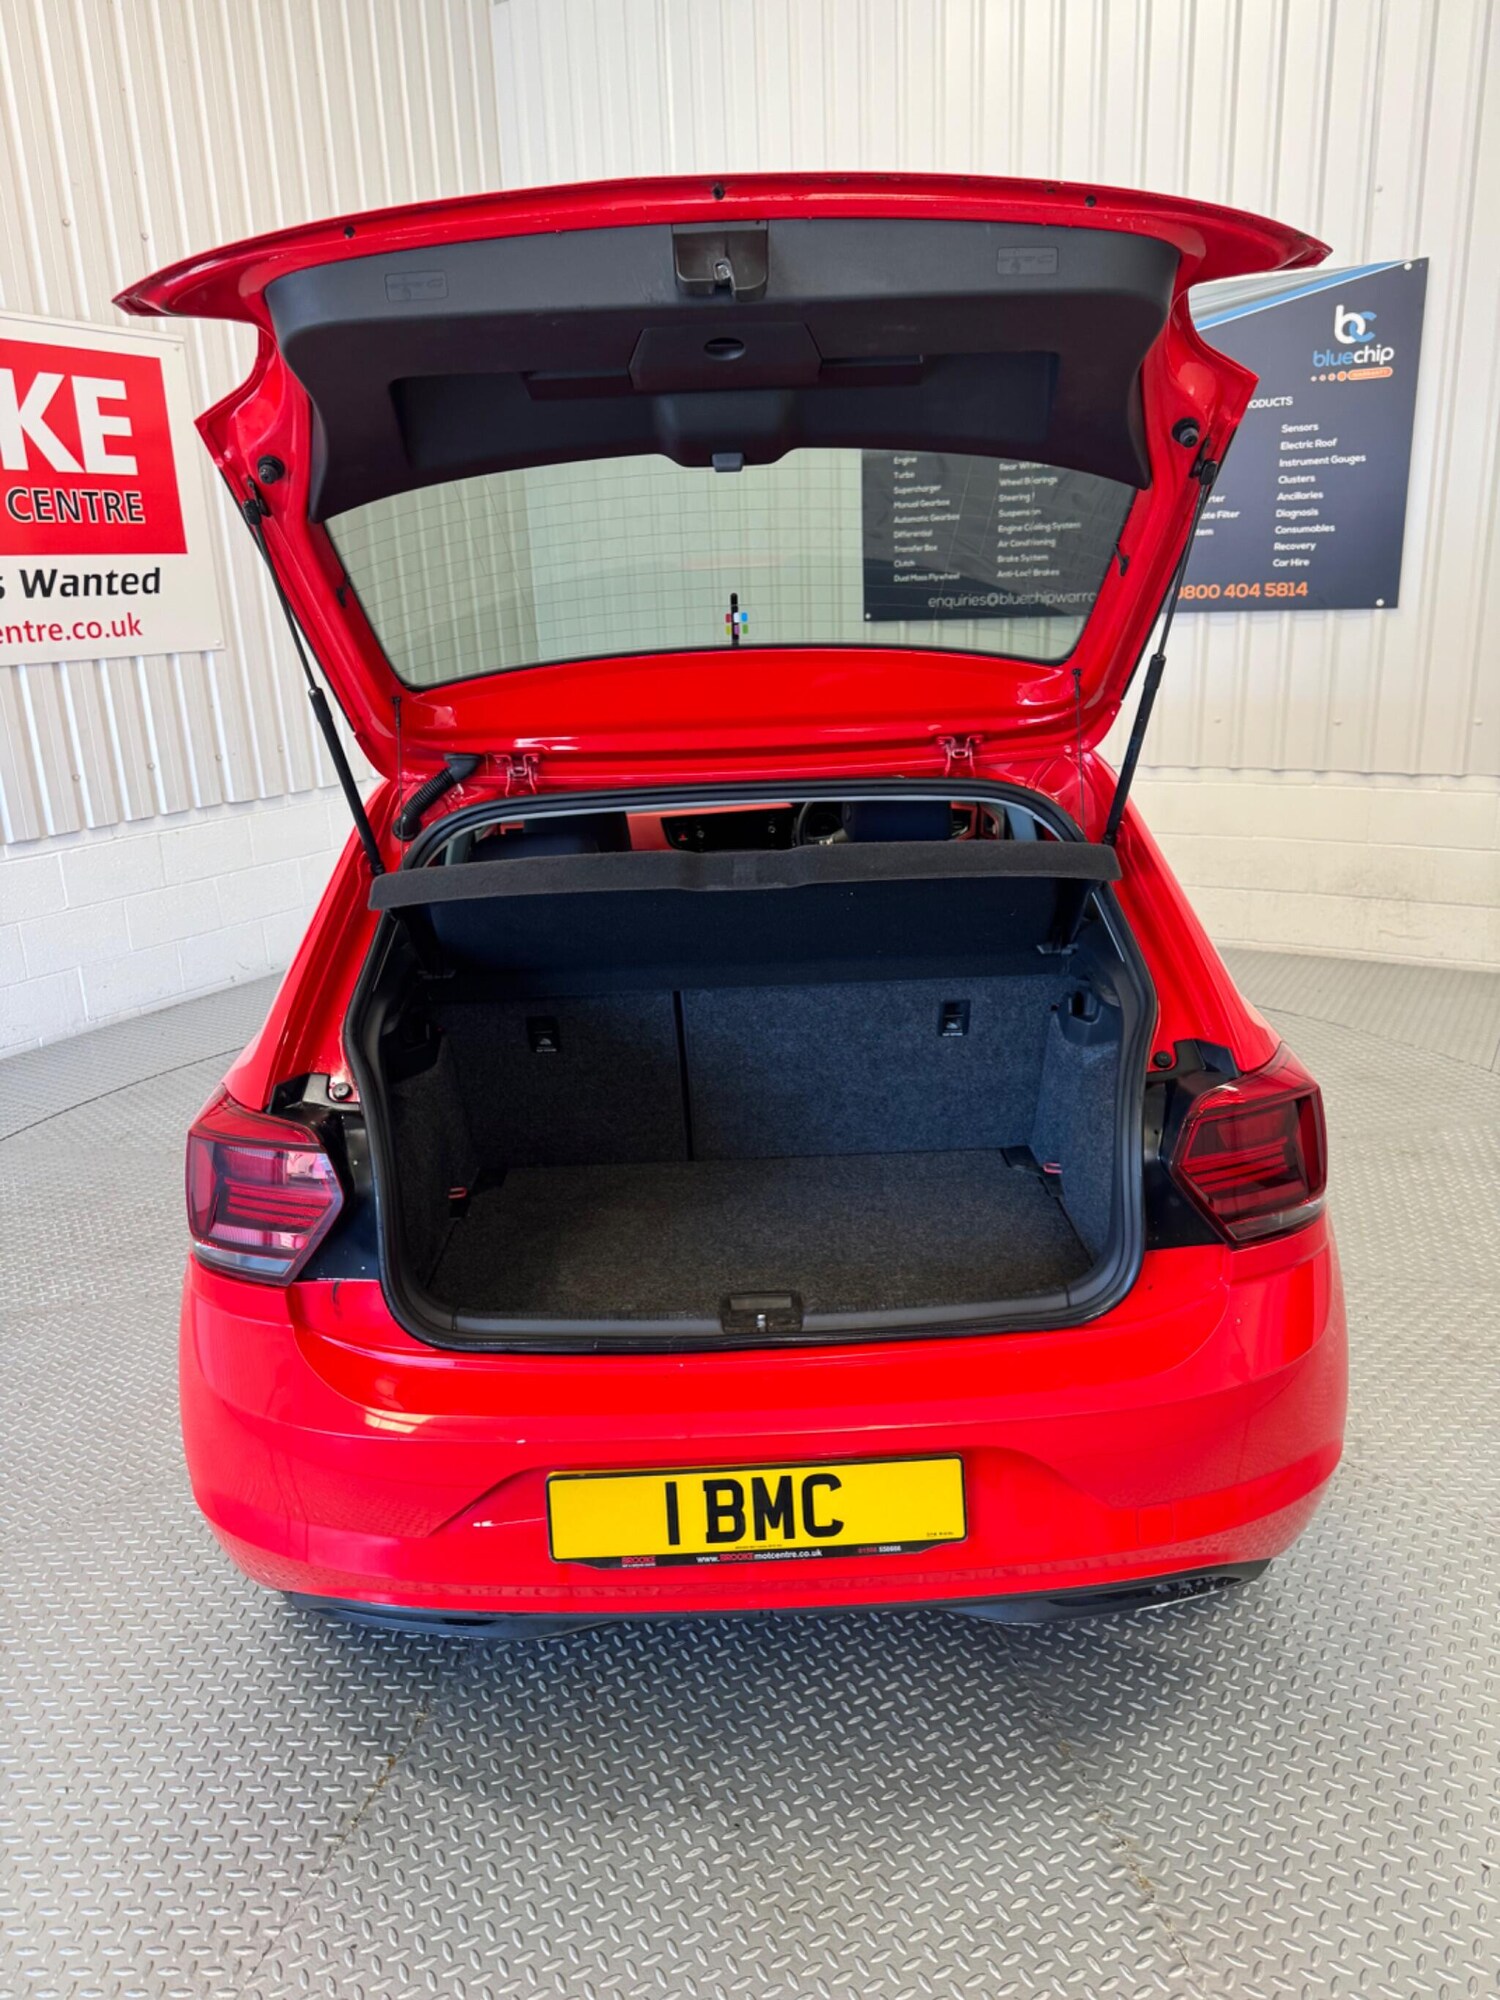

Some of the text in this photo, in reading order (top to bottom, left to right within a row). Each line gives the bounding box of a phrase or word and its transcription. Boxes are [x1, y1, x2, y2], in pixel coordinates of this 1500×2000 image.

[1312, 344, 1395, 368] bluechip
[1281, 424, 1319, 434] Sensors
[1280, 438, 1338, 451] Electric Roof
[894, 456, 917, 466] Engine
[1279, 455, 1367, 468] Instrument Gauges
[1278, 475, 1317, 485] Clusters
[1276, 491, 1324, 501] Ancillaries
[5, 486, 146, 524] CENTRE
[1275, 508, 1319, 520] Diagnosis
[998, 525, 1022, 535] Engine
[1274, 524, 1336, 535] Consumables
[1273, 542, 1317, 552] Recovery
[1272, 558, 1310, 567] Car Hire
[19, 567, 161, 598] Wanted
[1224, 582, 1260, 599] 404
[1264, 581, 1308, 597] 5814
[0, 612, 143, 645] ntre.co.uk
[702, 1473, 845, 1544] BMC
